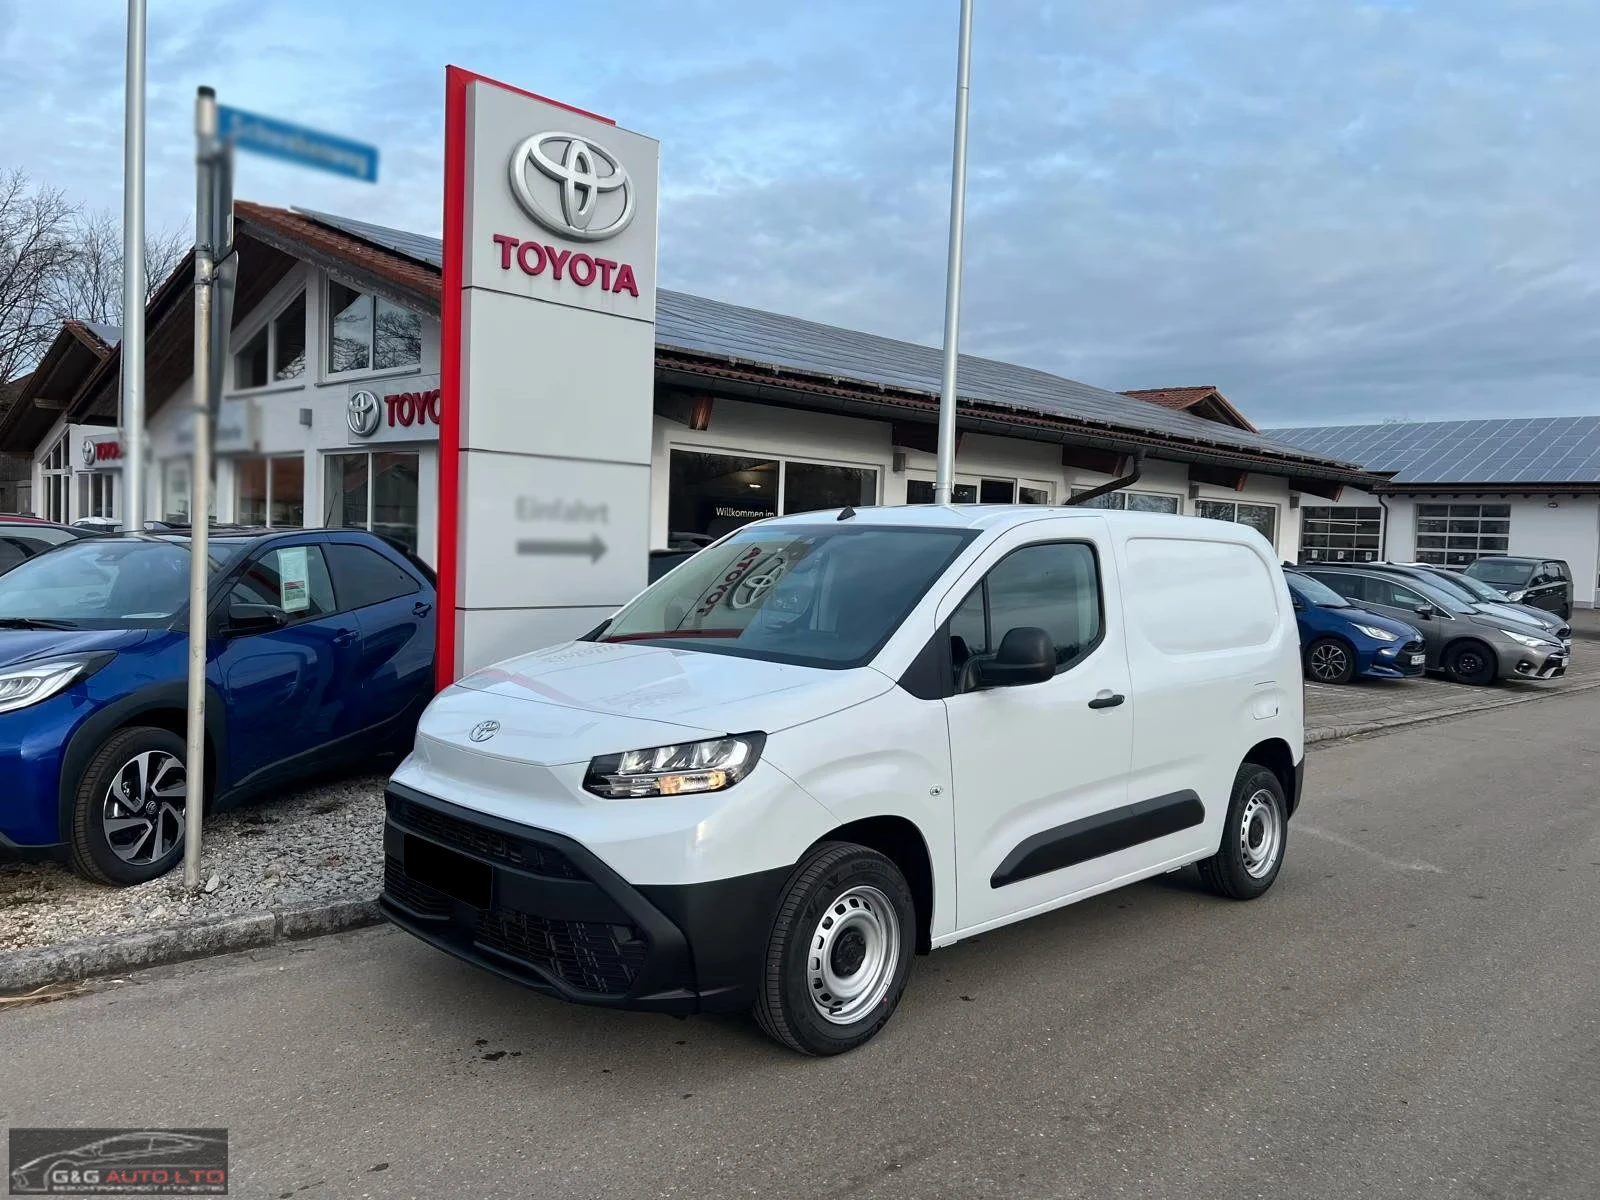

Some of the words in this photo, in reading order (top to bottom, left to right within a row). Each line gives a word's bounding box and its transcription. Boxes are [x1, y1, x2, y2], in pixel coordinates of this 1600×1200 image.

[493, 233, 639, 298] TOYOTA
[384, 389, 441, 427] TOYO
[715, 506, 764, 518] Willkommen
